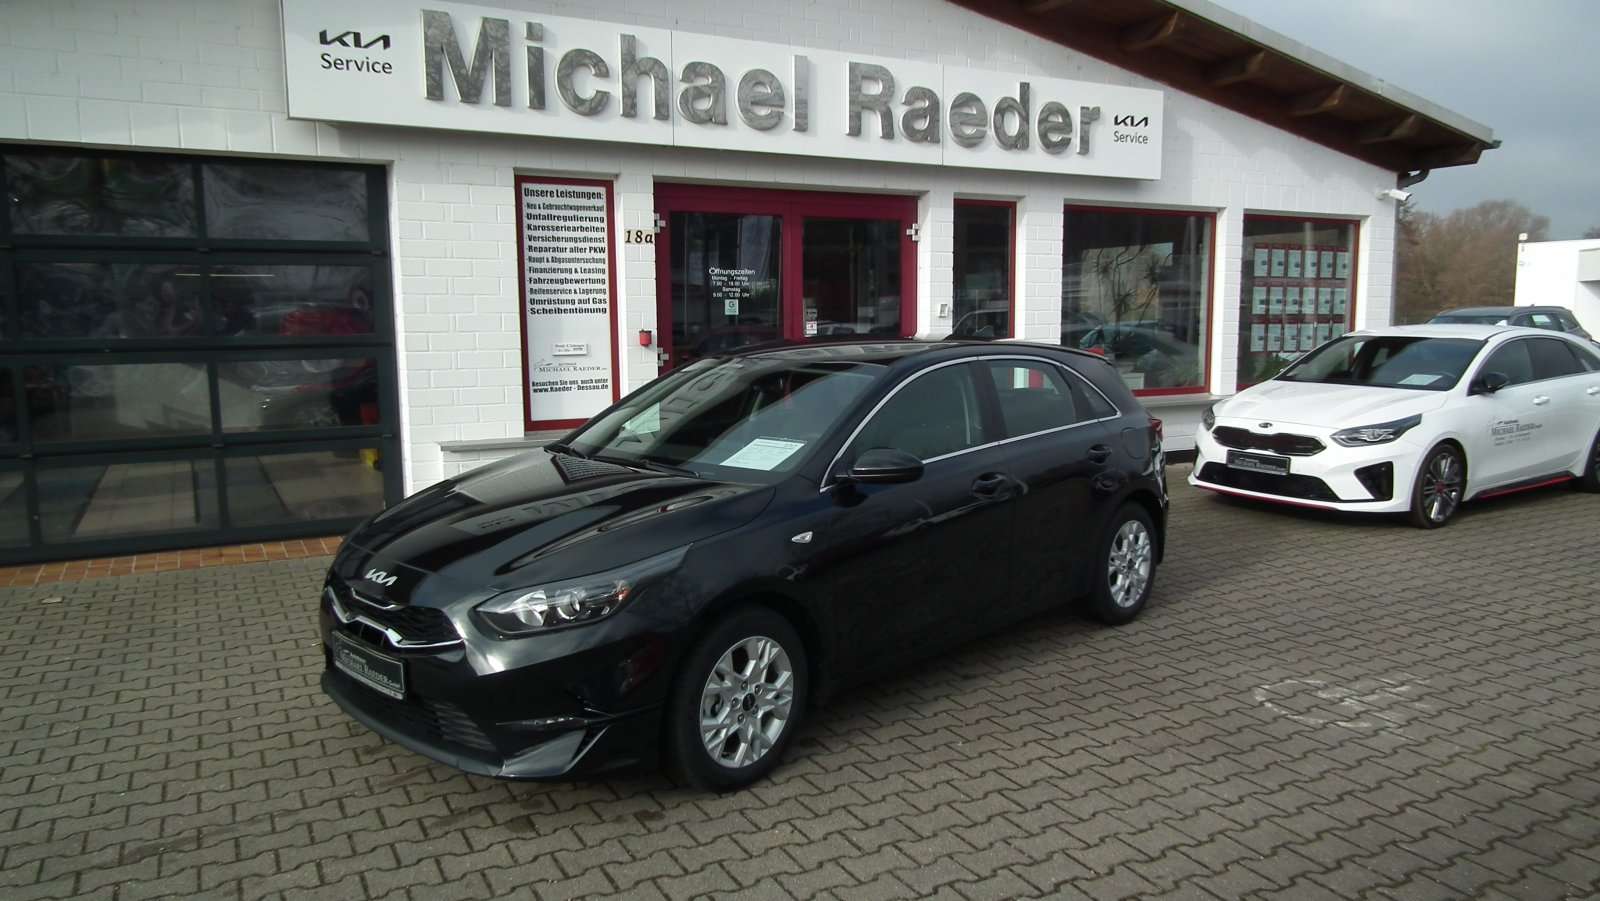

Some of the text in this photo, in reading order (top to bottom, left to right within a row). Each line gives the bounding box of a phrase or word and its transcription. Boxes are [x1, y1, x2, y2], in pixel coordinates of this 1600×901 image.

[318, 29, 391, 50] KIA
[320, 52, 393, 75] Service
[420, 8, 1100, 155] Michael Raeder
[1113, 114, 1149, 128] KIA
[1113, 129, 1149, 145] Service
[523, 187, 604, 200] Unsere Leistungen:
[526, 212, 605, 223] Unfallregulierung
[527, 223, 605, 233] Karosseriearbeiten
[527, 234, 605, 244] Versicherungsdienst
[625, 230, 654, 244] 18a
[528, 245, 606, 254] Reparatur aller PKW
[528, 266, 573, 275] Finanzierung
[580, 267, 606, 275] Leasing
[708, 266, 756, 277] Öffnungszeiten
[528, 277, 606, 286] Fahrzeugbewertung
[578, 287, 607, 296] Lagerung
[529, 297, 608, 306] Umrüstung auf Gas
[530, 307, 607, 315] Scheibentönung
[364, 568, 398, 587] KIA
